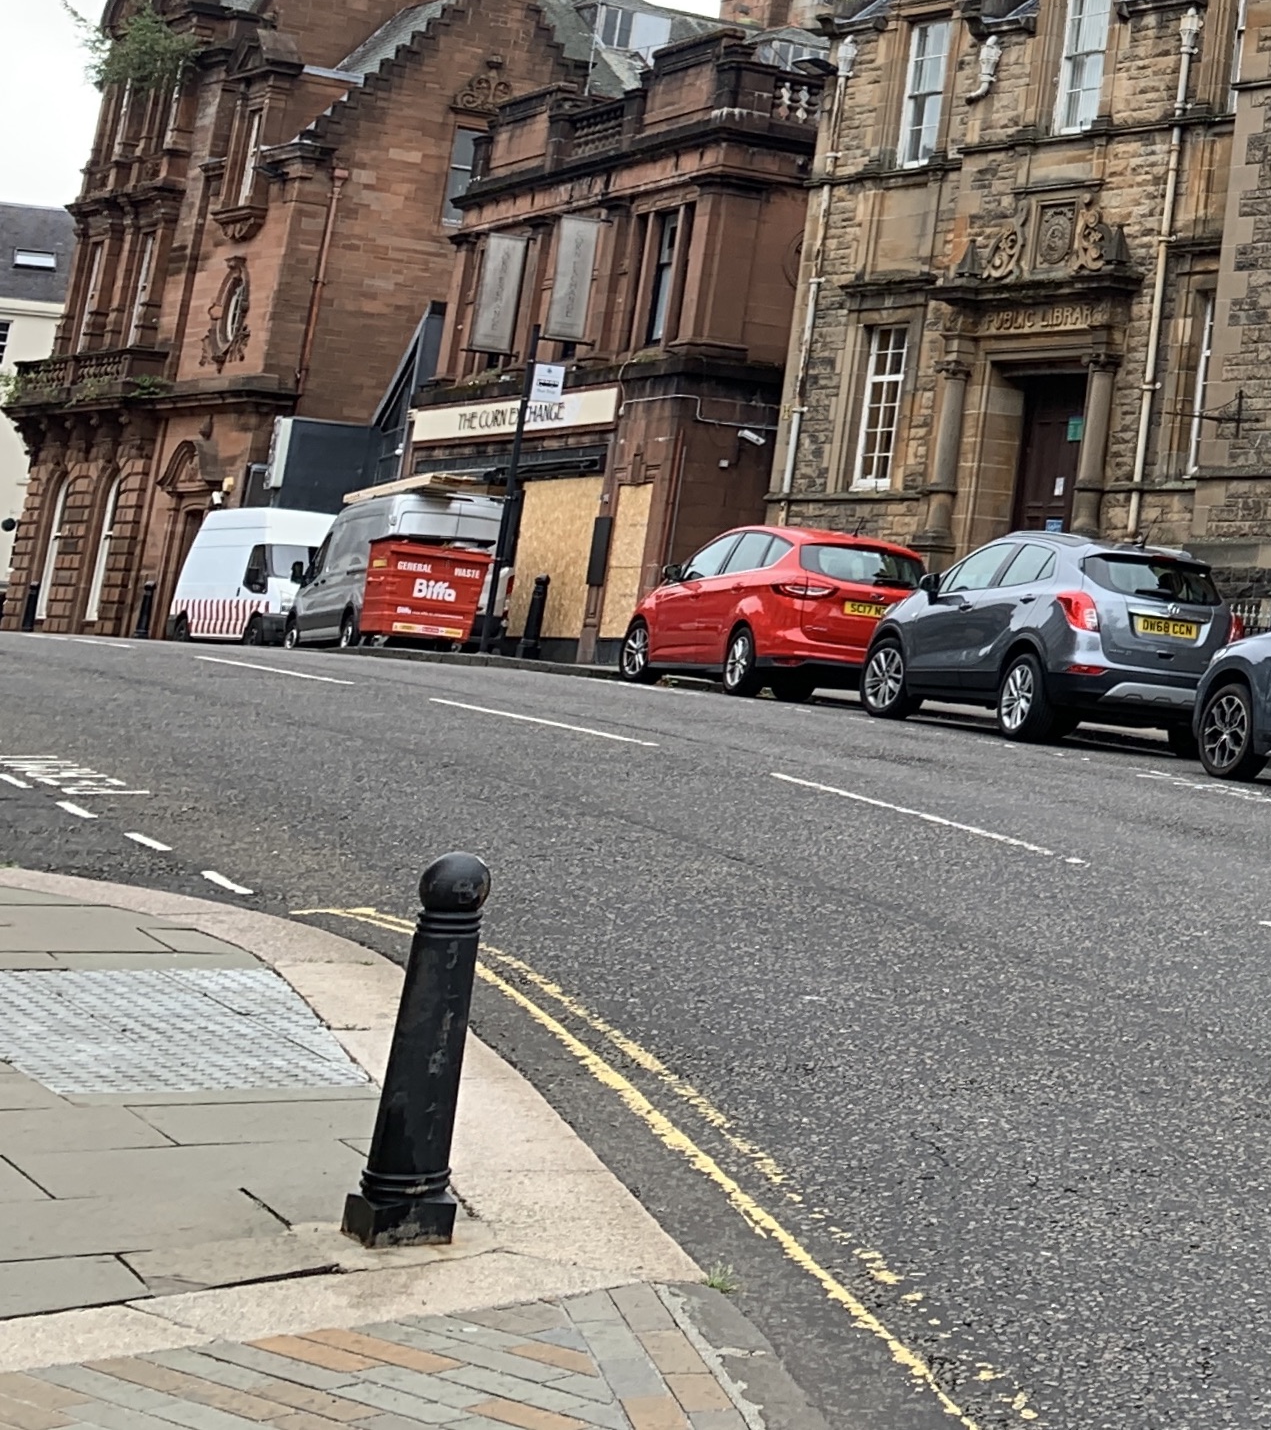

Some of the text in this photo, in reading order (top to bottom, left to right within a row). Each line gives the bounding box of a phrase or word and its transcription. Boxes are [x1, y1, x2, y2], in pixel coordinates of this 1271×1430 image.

[985, 310, 1035, 330] PUBLIC
[458, 412, 477, 431] THE
[479, 410, 507, 429] CORN
[397, 561, 480, 579] GENERAL WASTE
[412, 578, 457, 602] Biffa
[850, 603, 874, 615] SC17
[1142, 619, 1193, 636] DW68 CCN
